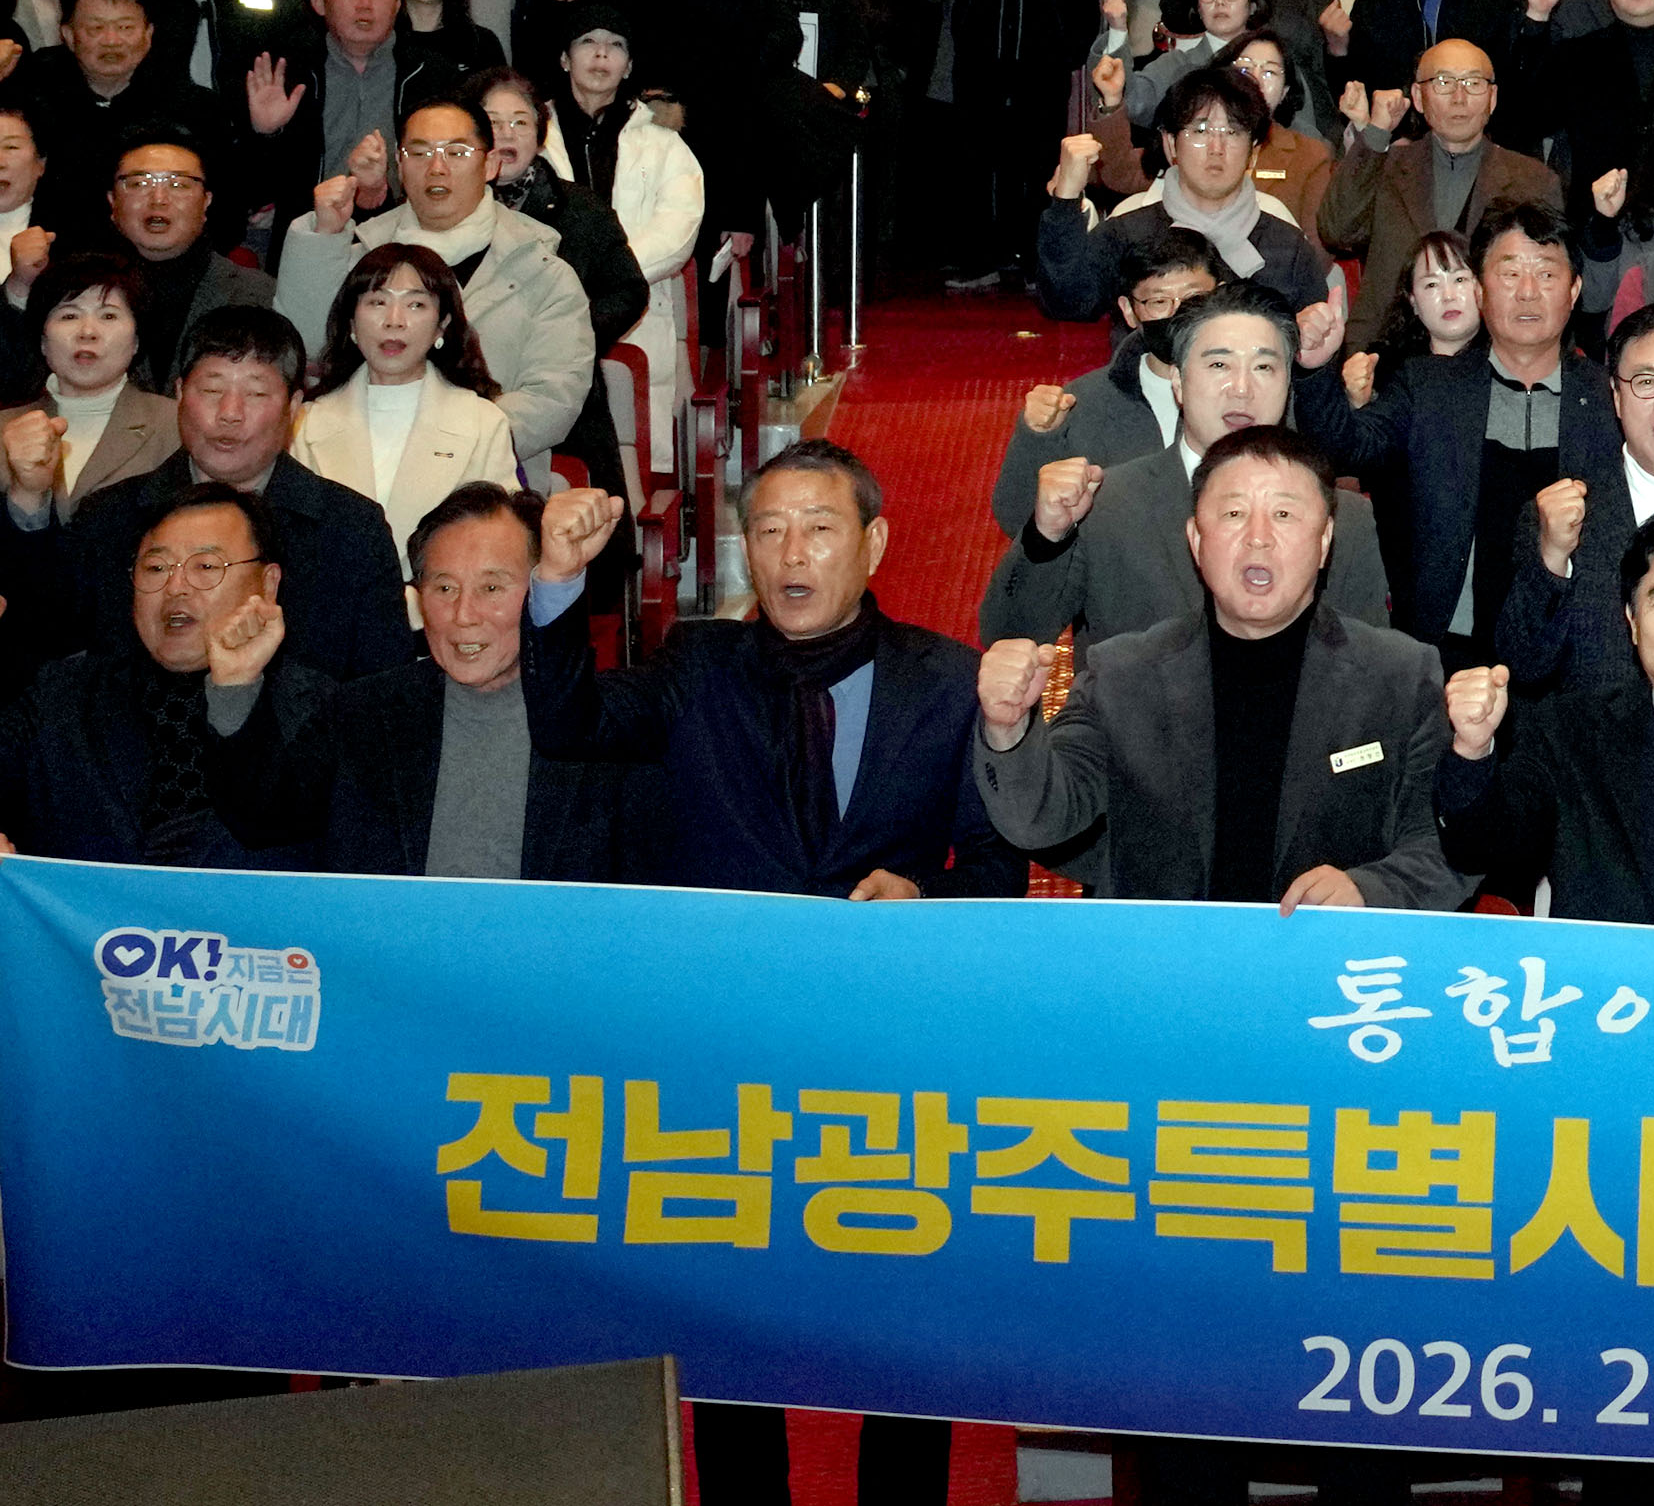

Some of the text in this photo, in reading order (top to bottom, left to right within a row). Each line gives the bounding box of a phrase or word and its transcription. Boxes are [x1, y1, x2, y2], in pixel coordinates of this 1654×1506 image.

[102, 934, 313, 984] OK! 지금은
[108, 987, 314, 1044] 전남시대
[1298, 1335, 1558, 1423] 2026.
